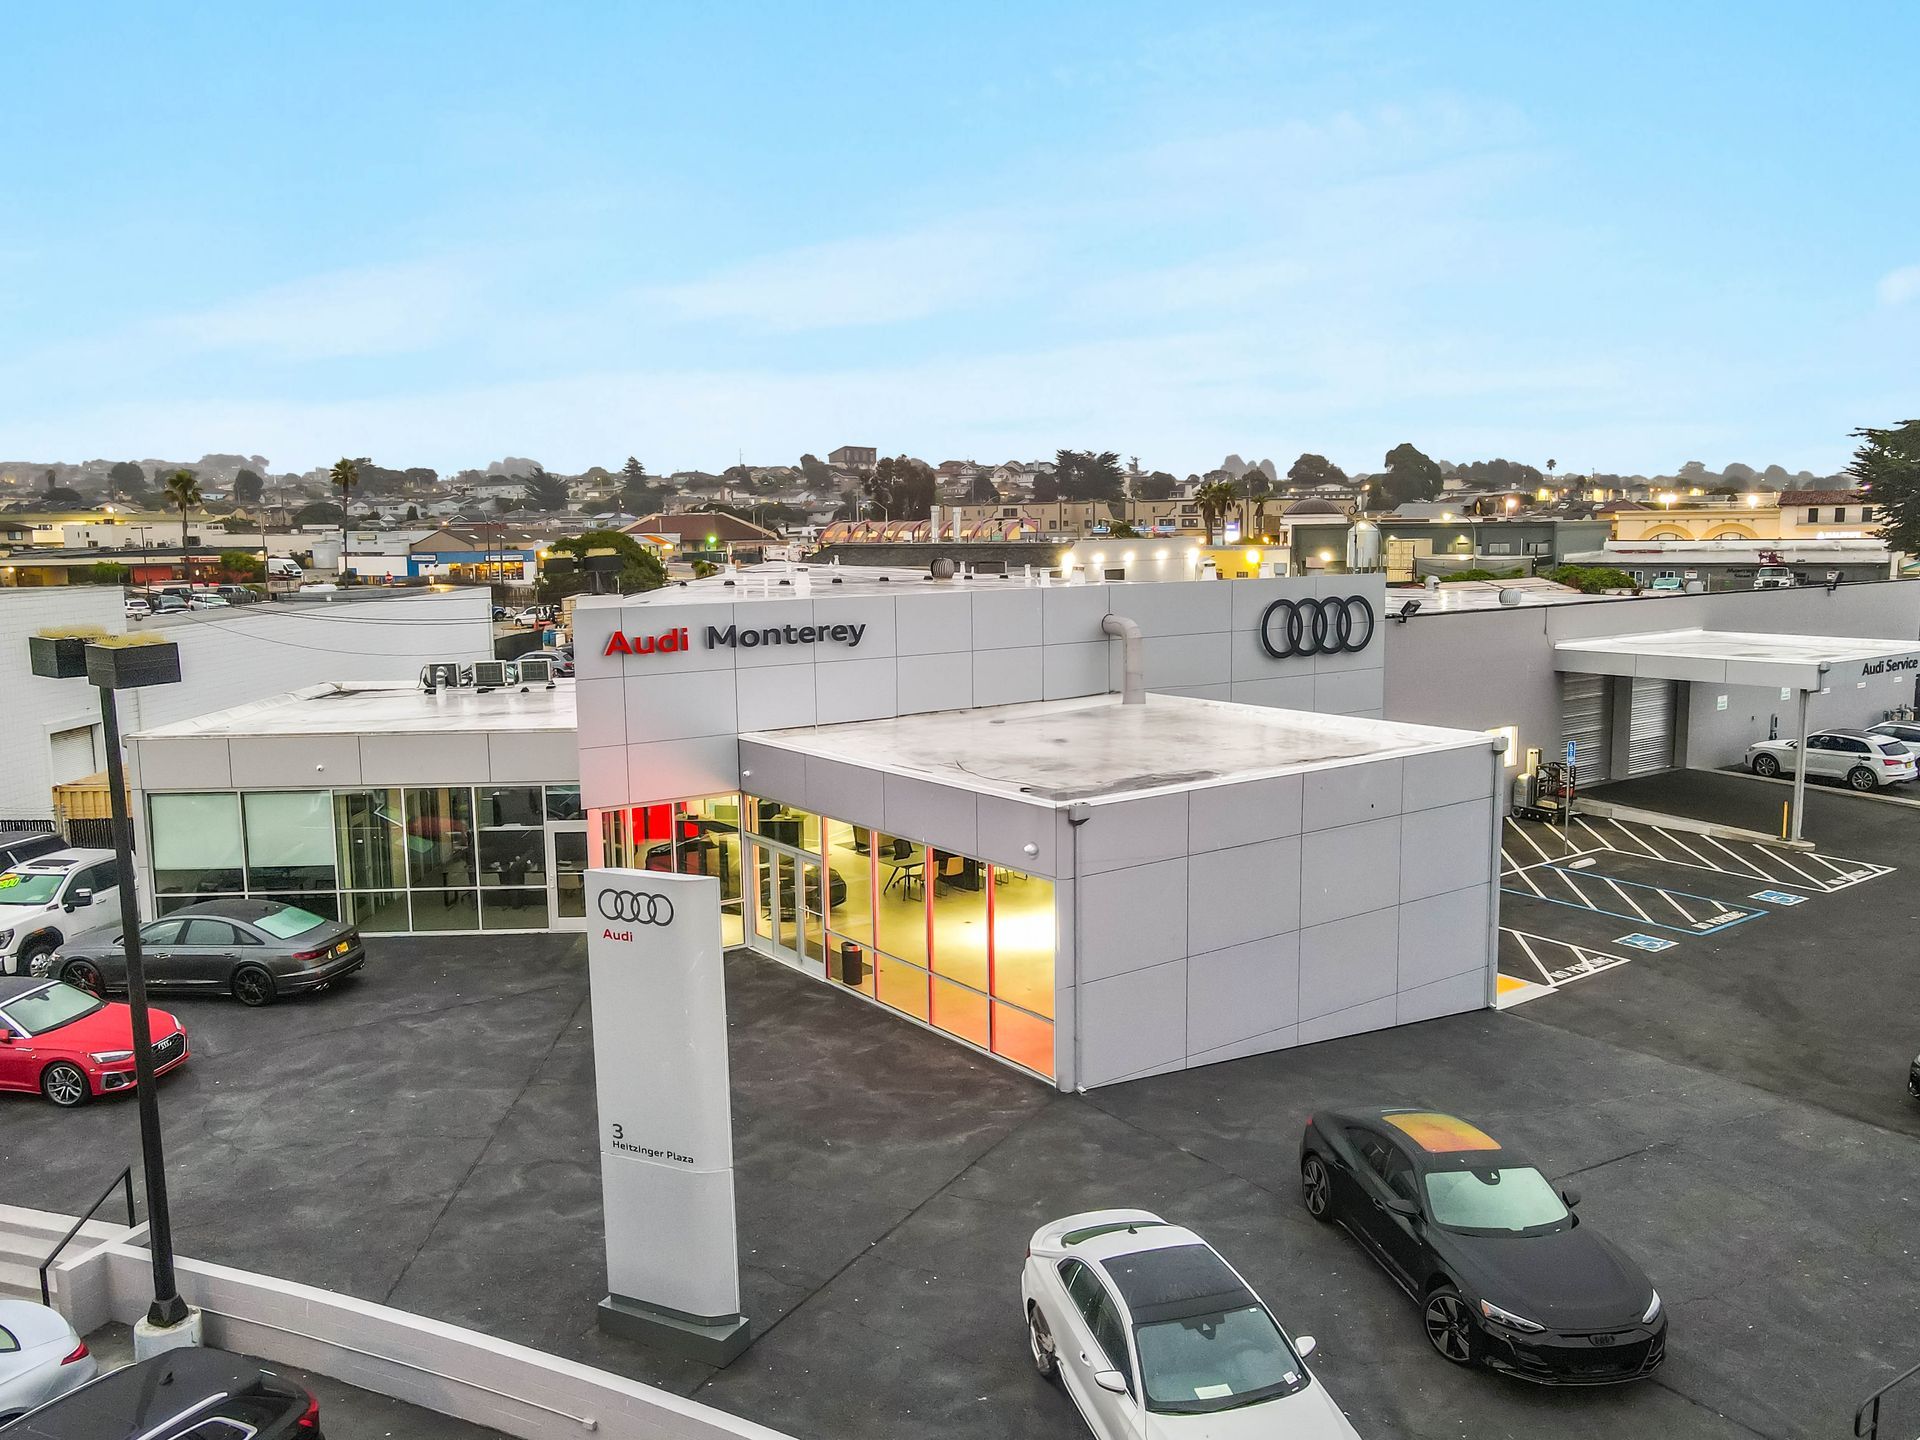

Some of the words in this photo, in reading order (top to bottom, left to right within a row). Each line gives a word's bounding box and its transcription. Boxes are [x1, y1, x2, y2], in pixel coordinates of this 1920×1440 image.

[604, 627, 689, 656] Audi
[706, 623, 867, 650] Monterey
[1861, 661, 1884, 676] Audi
[1886, 657, 1919, 673] Service
[603, 928, 633, 942] Audi
[612, 1123, 624, 1140] 3
[612, 1140, 664, 1158] Heitzinger
[666, 1150, 694, 1164] Plaza
